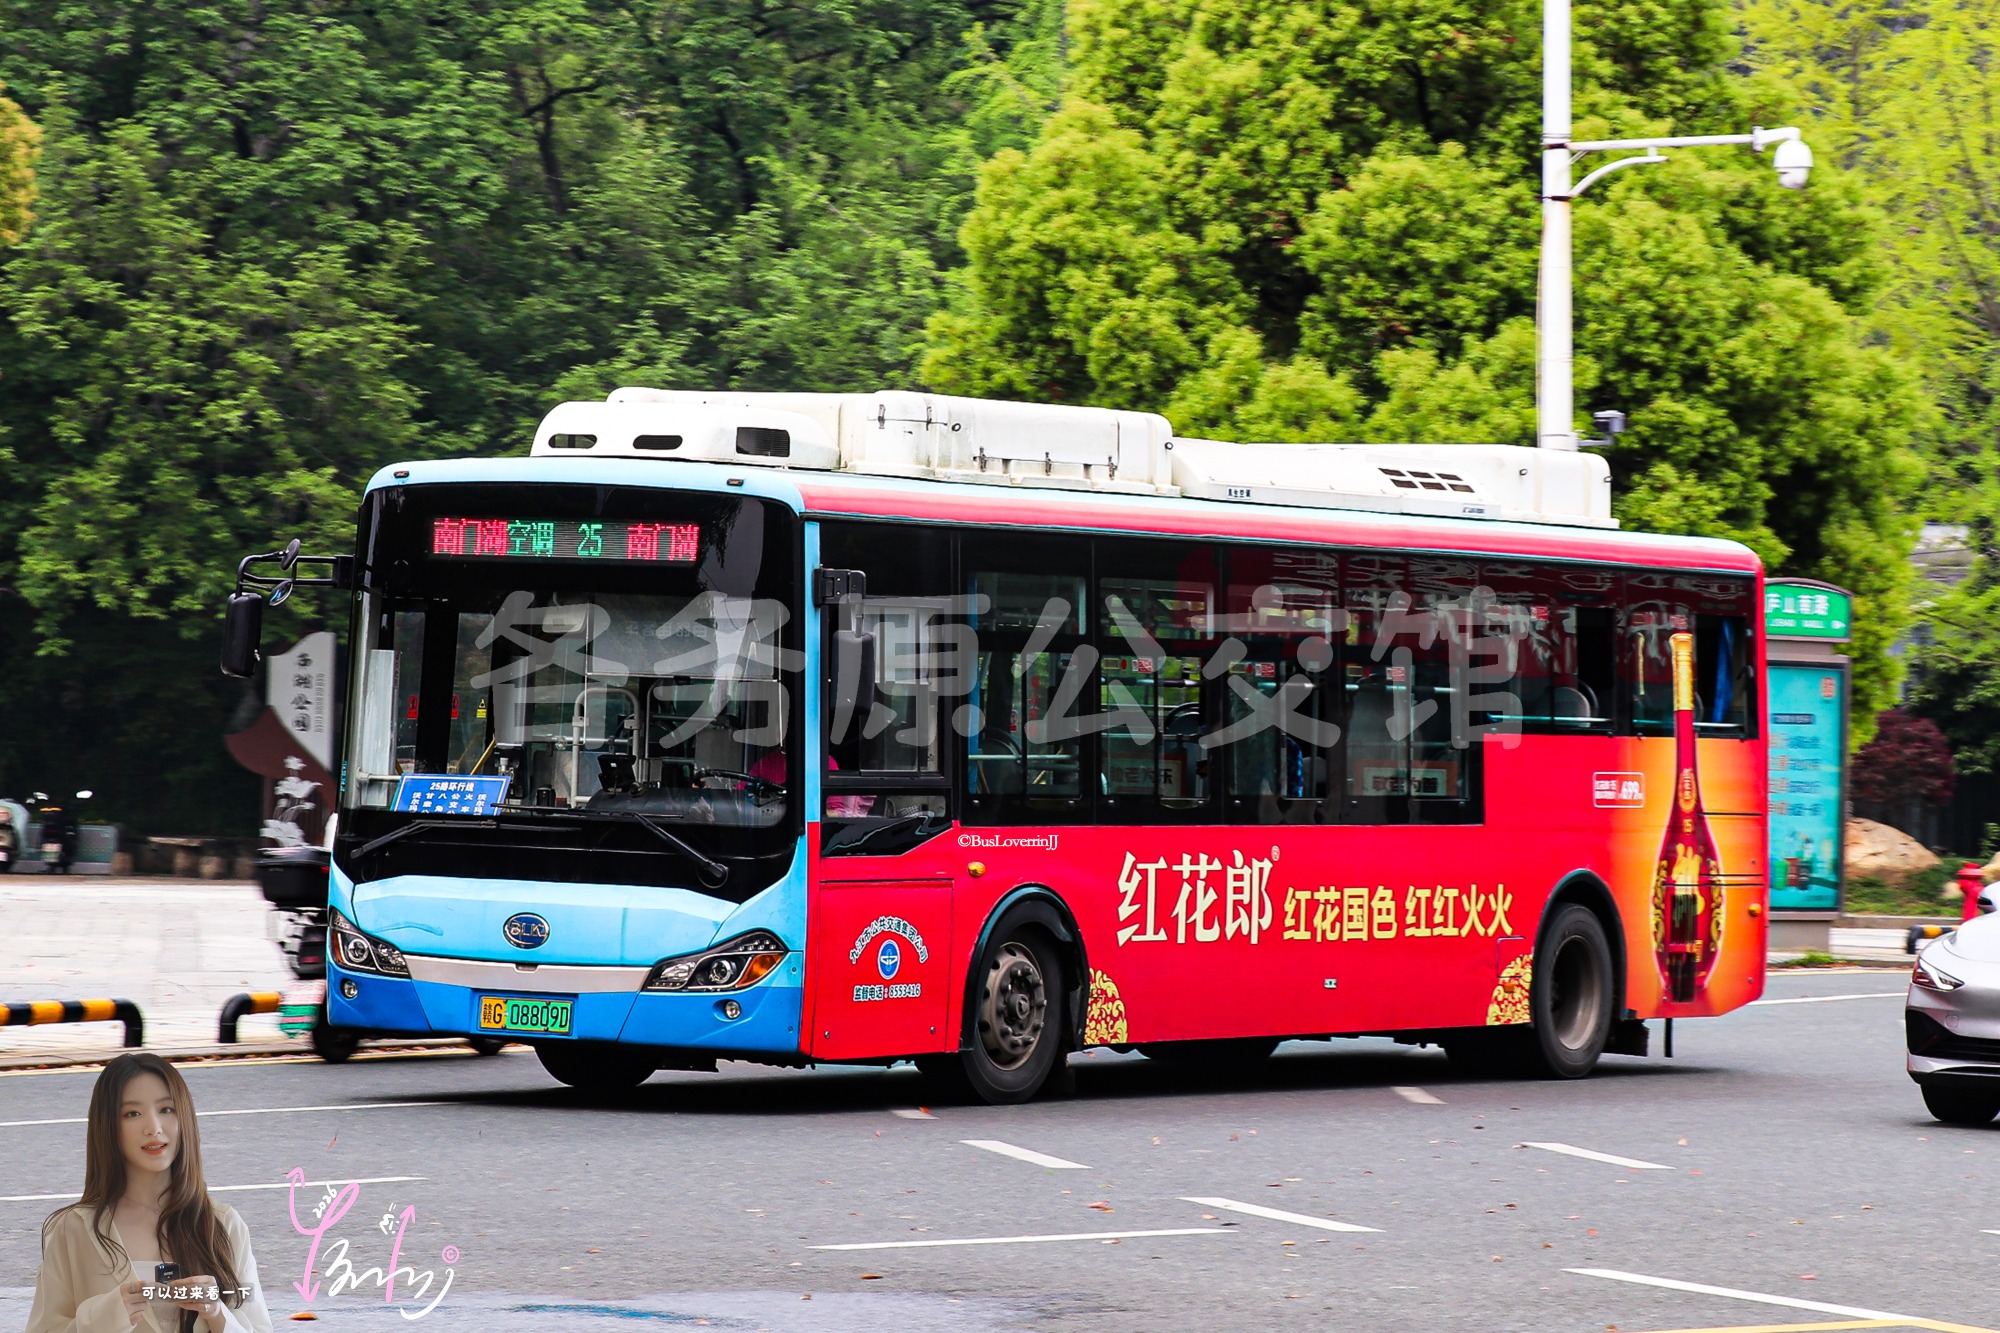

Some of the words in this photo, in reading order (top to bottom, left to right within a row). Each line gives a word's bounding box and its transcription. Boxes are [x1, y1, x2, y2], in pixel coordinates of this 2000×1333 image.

[578, 523, 603, 556] 25
[628, 523, 699, 560] 南门湖
[1116, 849, 1273, 947] 红花郎
[1283, 886, 1398, 942] 红花国色
[1404, 883, 1514, 937] 红红火火
